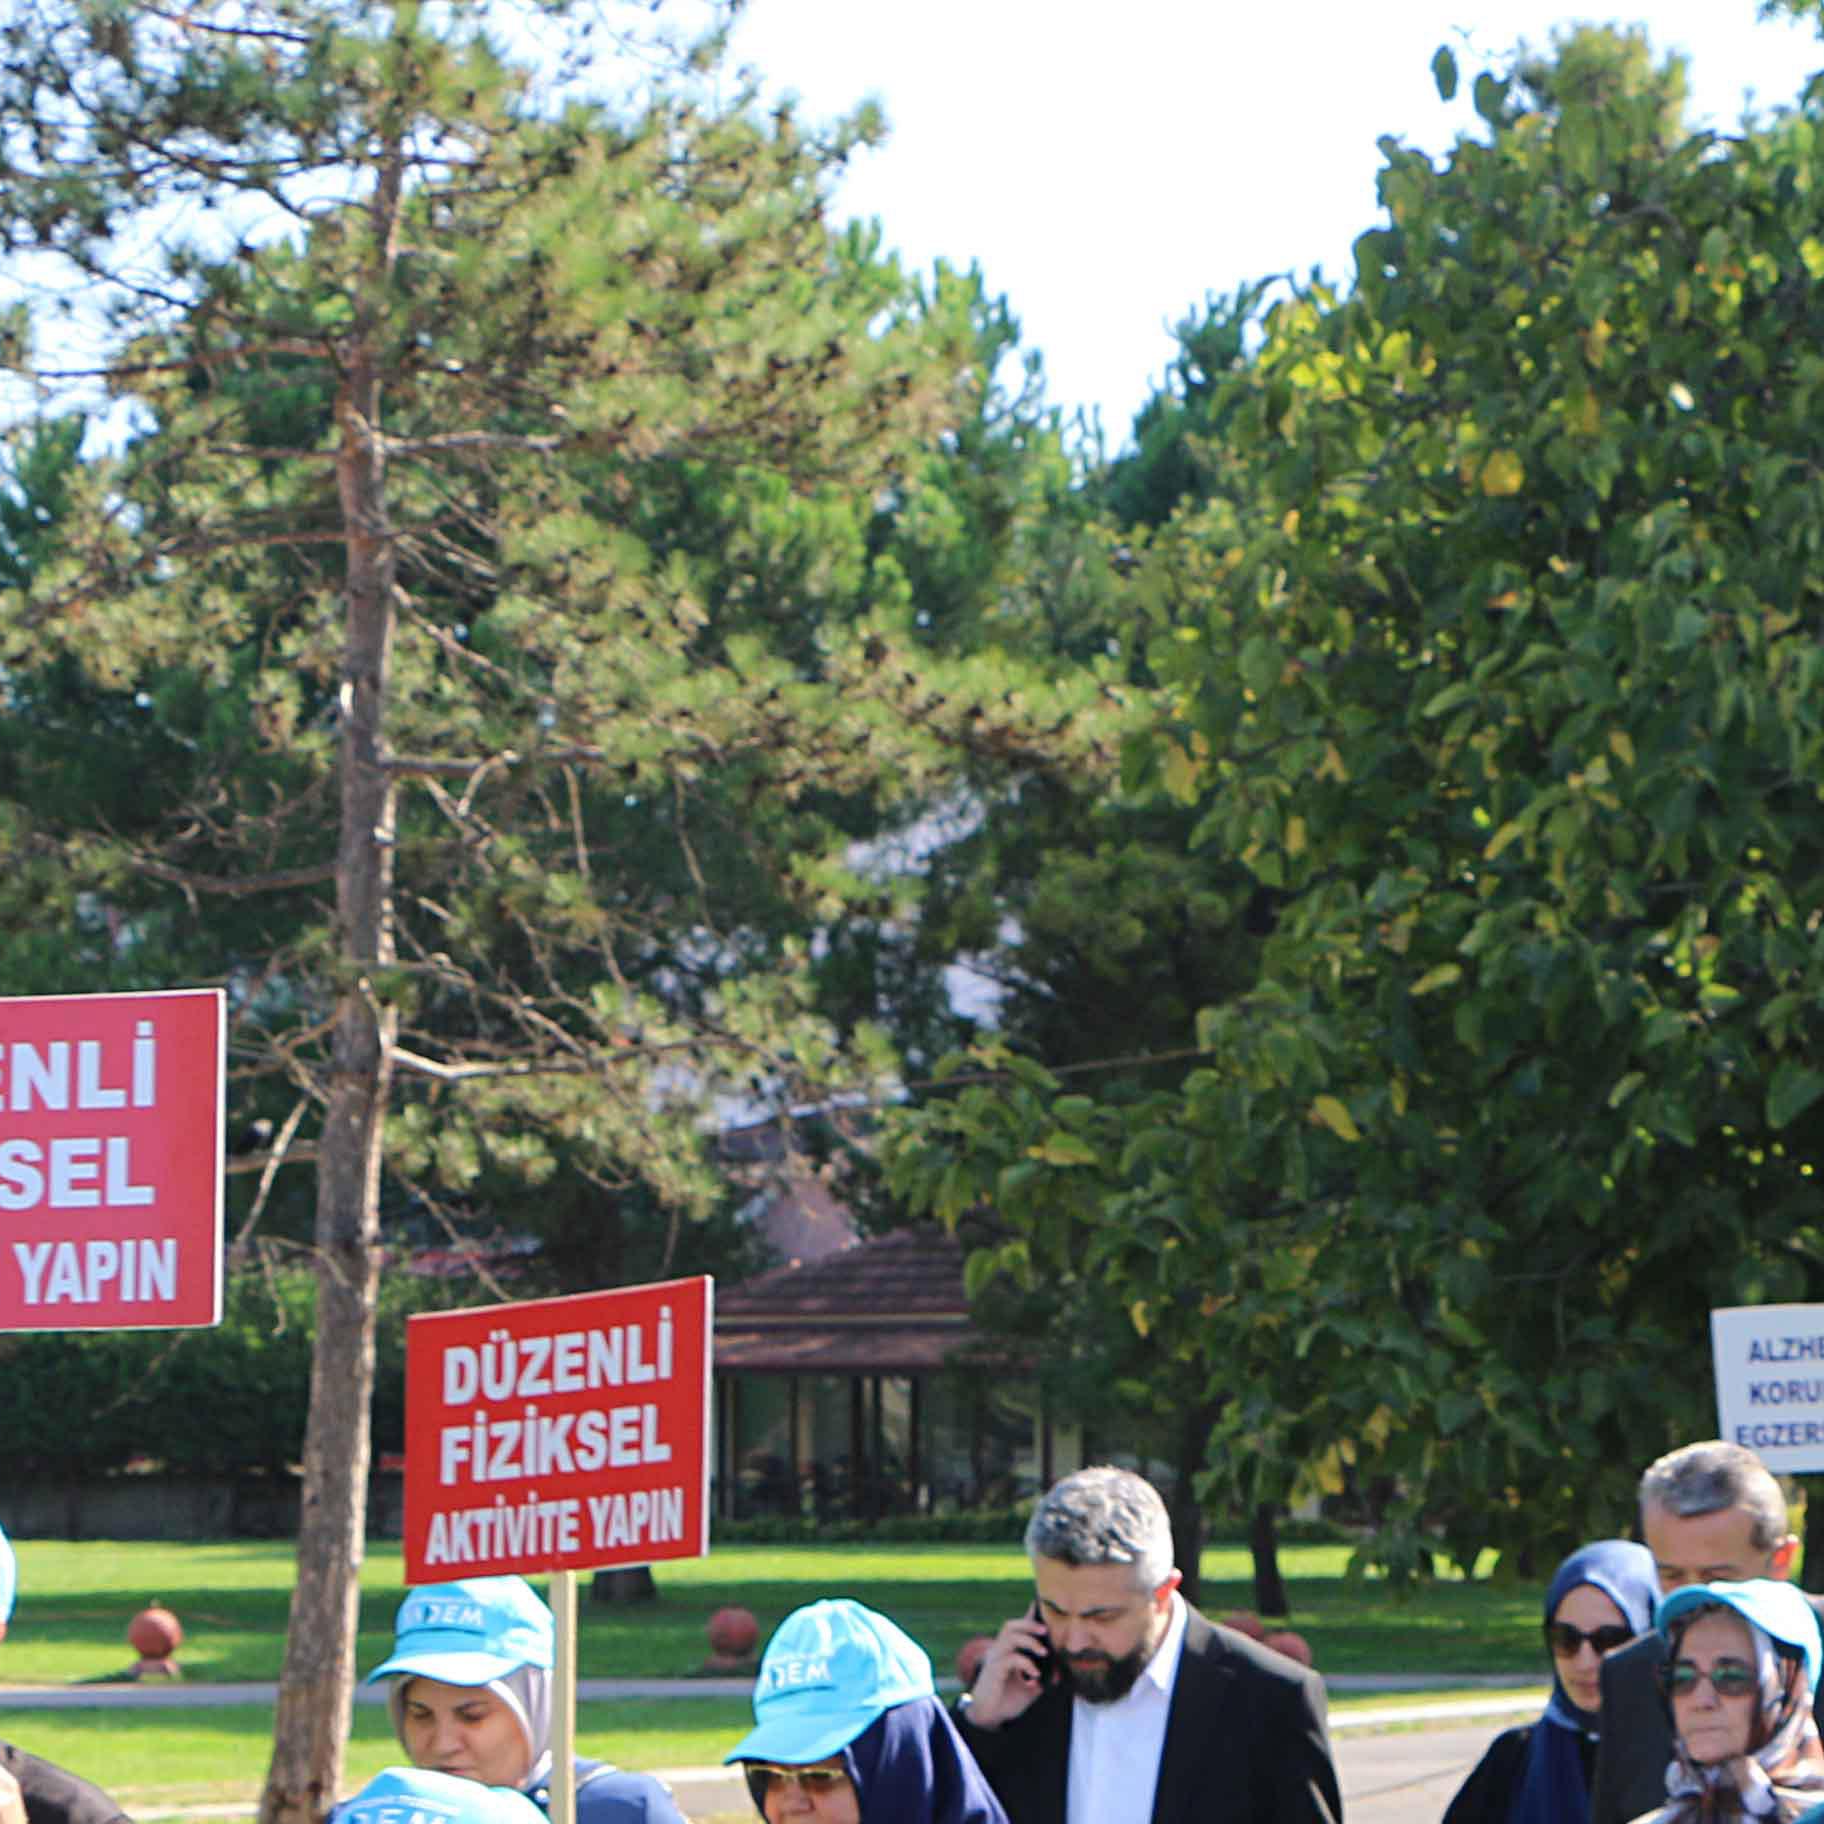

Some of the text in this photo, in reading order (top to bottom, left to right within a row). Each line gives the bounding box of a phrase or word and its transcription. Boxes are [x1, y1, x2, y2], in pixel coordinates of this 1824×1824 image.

[11, 1237, 178, 1306] YAPIN
[442, 1305, 674, 1406] DÜZENLİ
[440, 1403, 672, 1486] FİZİKSEL
[425, 1486, 684, 1566] AKTİVİTE YAPIN
